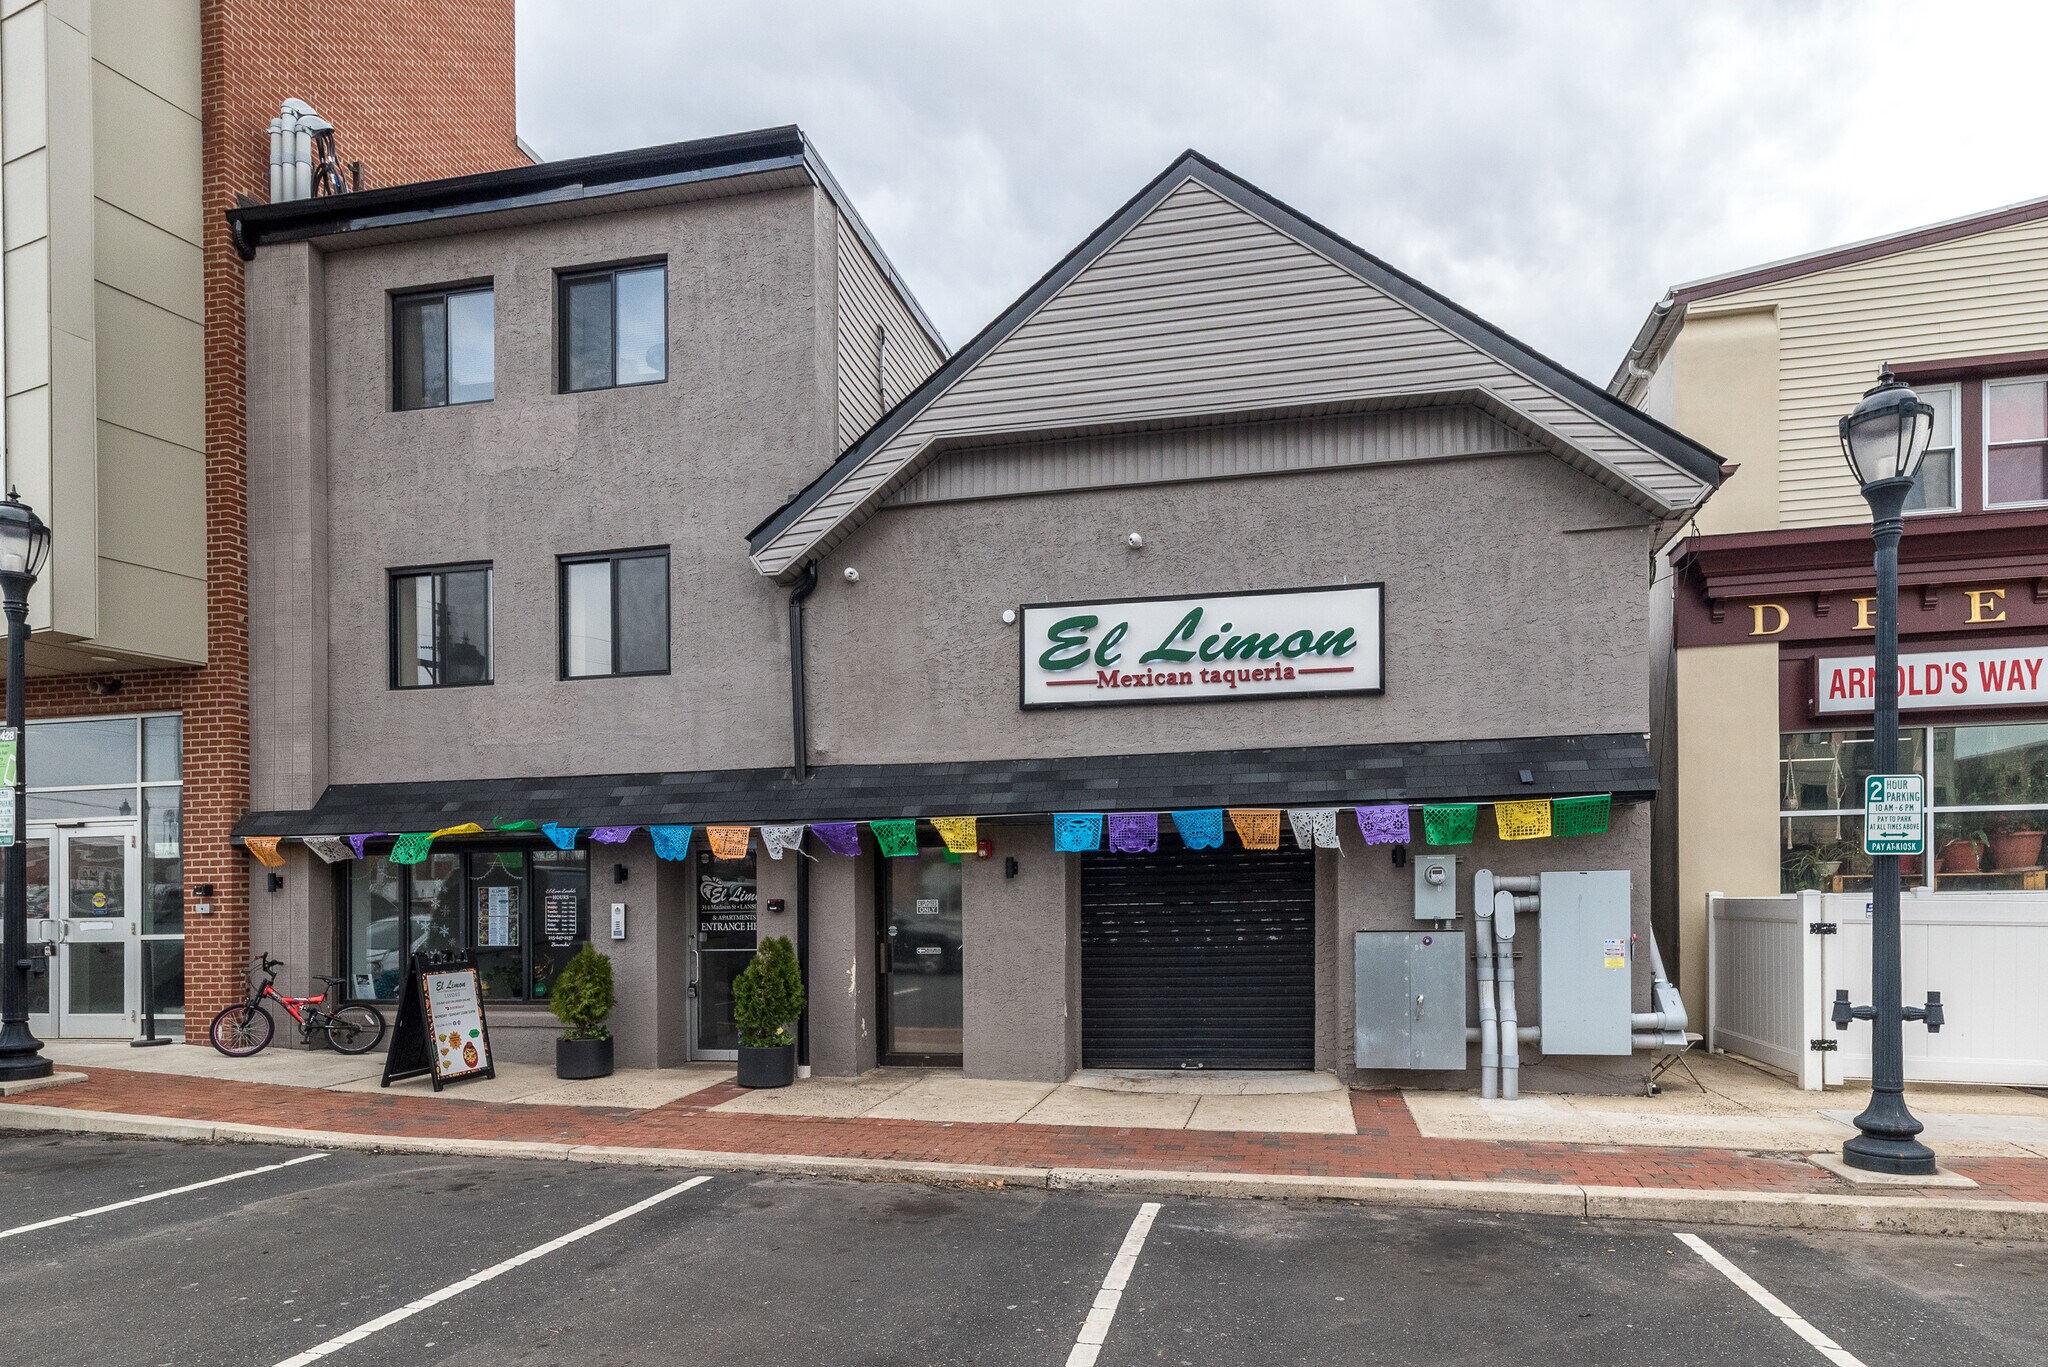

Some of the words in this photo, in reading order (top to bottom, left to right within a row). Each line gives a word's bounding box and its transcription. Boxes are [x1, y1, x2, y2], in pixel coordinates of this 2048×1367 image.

[1039, 614, 1129, 671] El
[1139, 606, 1357, 664] Limon
[1096, 667, 1193, 689] Mexican
[1199, 661, 1296, 689] taqueria
[1978, 658, 2044, 693] WAY
[1886, 780, 1908, 790] HOUR
[1870, 781, 1883, 801] 2
[1886, 791, 1920, 802] PARKING
[1884, 804, 1894, 812] AM
[1899, 804, 1903, 812] 6
[1905, 804, 1914, 812] PM
[1877, 815, 1888, 823] PAY
[1889, 815, 1896, 823] TO
[1897, 815, 1912, 823] PARK
[1872, 842, 1886, 851] PAY
[1886, 842, 1895, 851] AT
[1896, 842, 1917, 851] KIOSK
[710, 887, 727, 903] El
[729, 886, 757, 902] Lim
[701, 922, 746, 931] ENTRANCE
[436, 981, 445, 991] El
[446, 980, 466, 989] Limon
